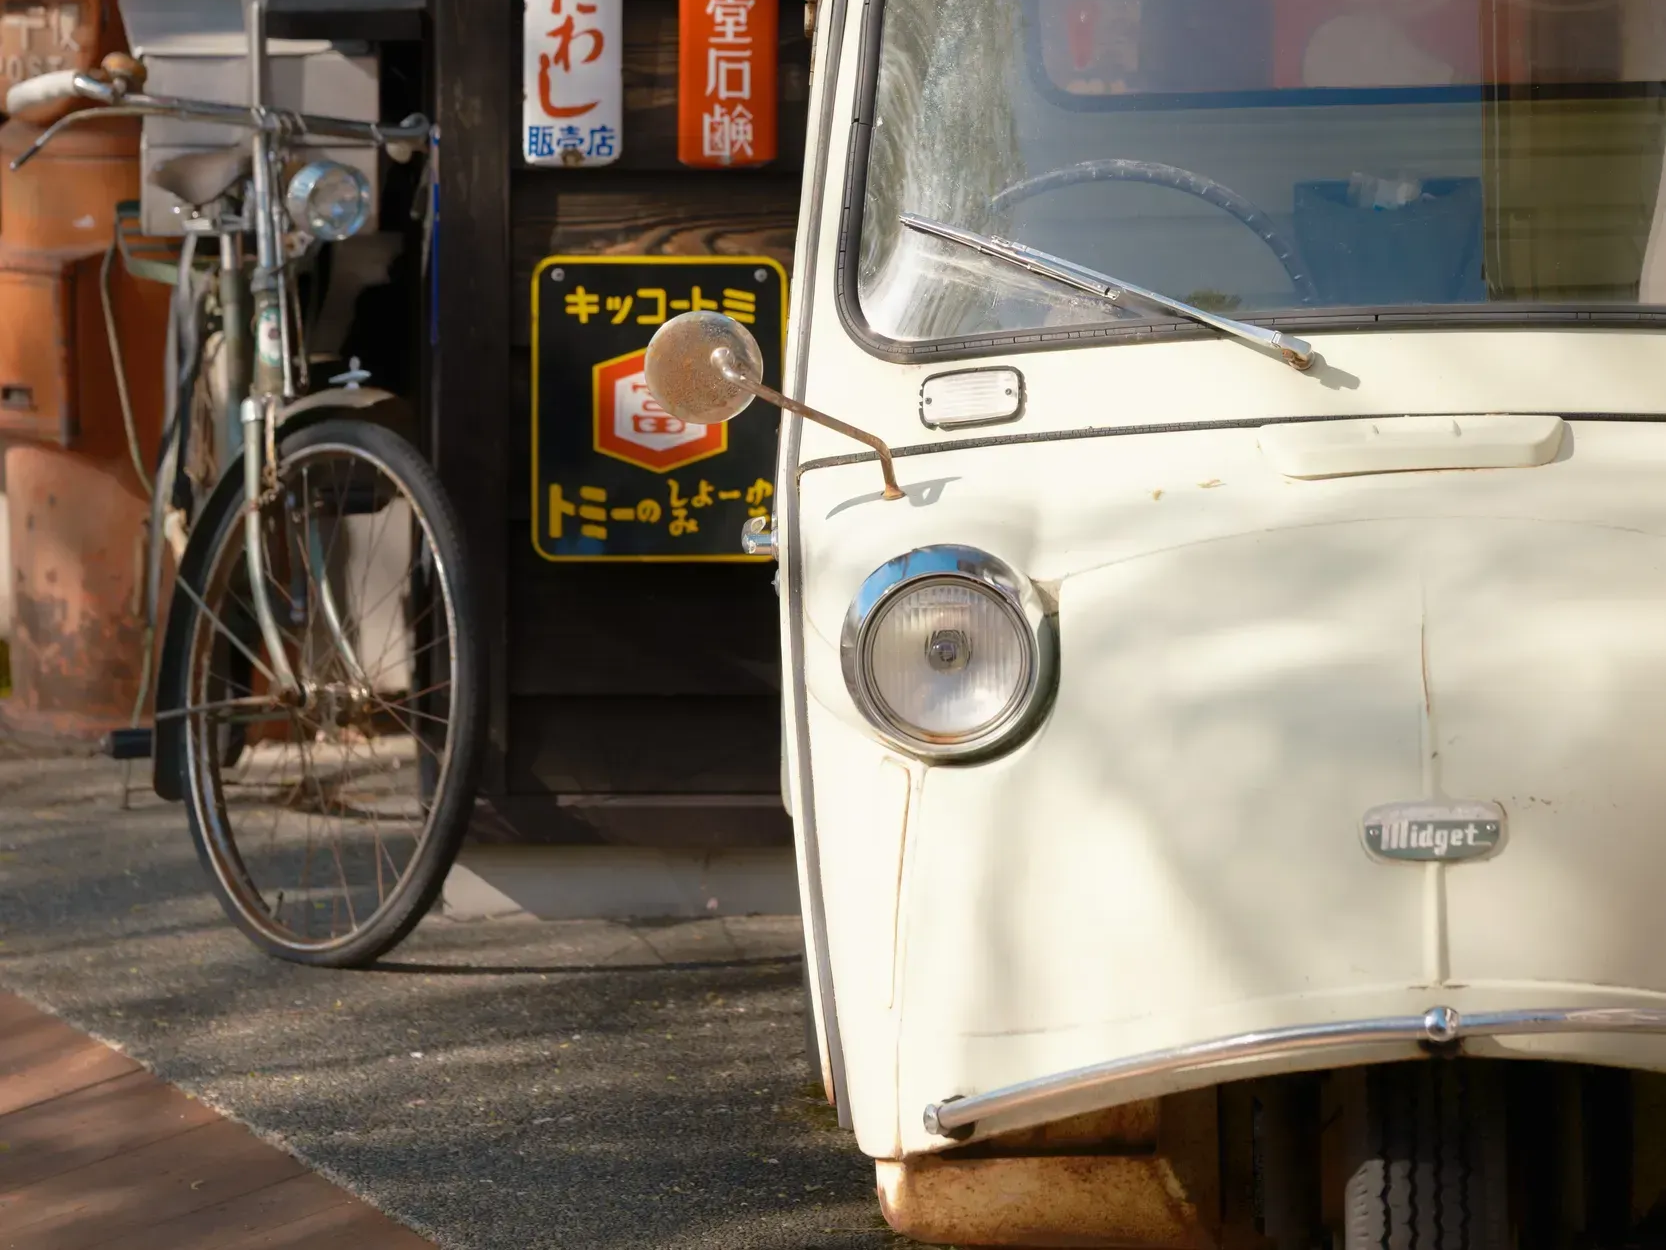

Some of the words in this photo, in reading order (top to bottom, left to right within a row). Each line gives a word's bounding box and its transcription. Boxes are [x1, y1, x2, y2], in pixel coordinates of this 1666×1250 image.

[528, 126, 615, 157] 販売店
[549, 483, 662, 540] トミーの
[1381, 820, 1478, 856] Midget
